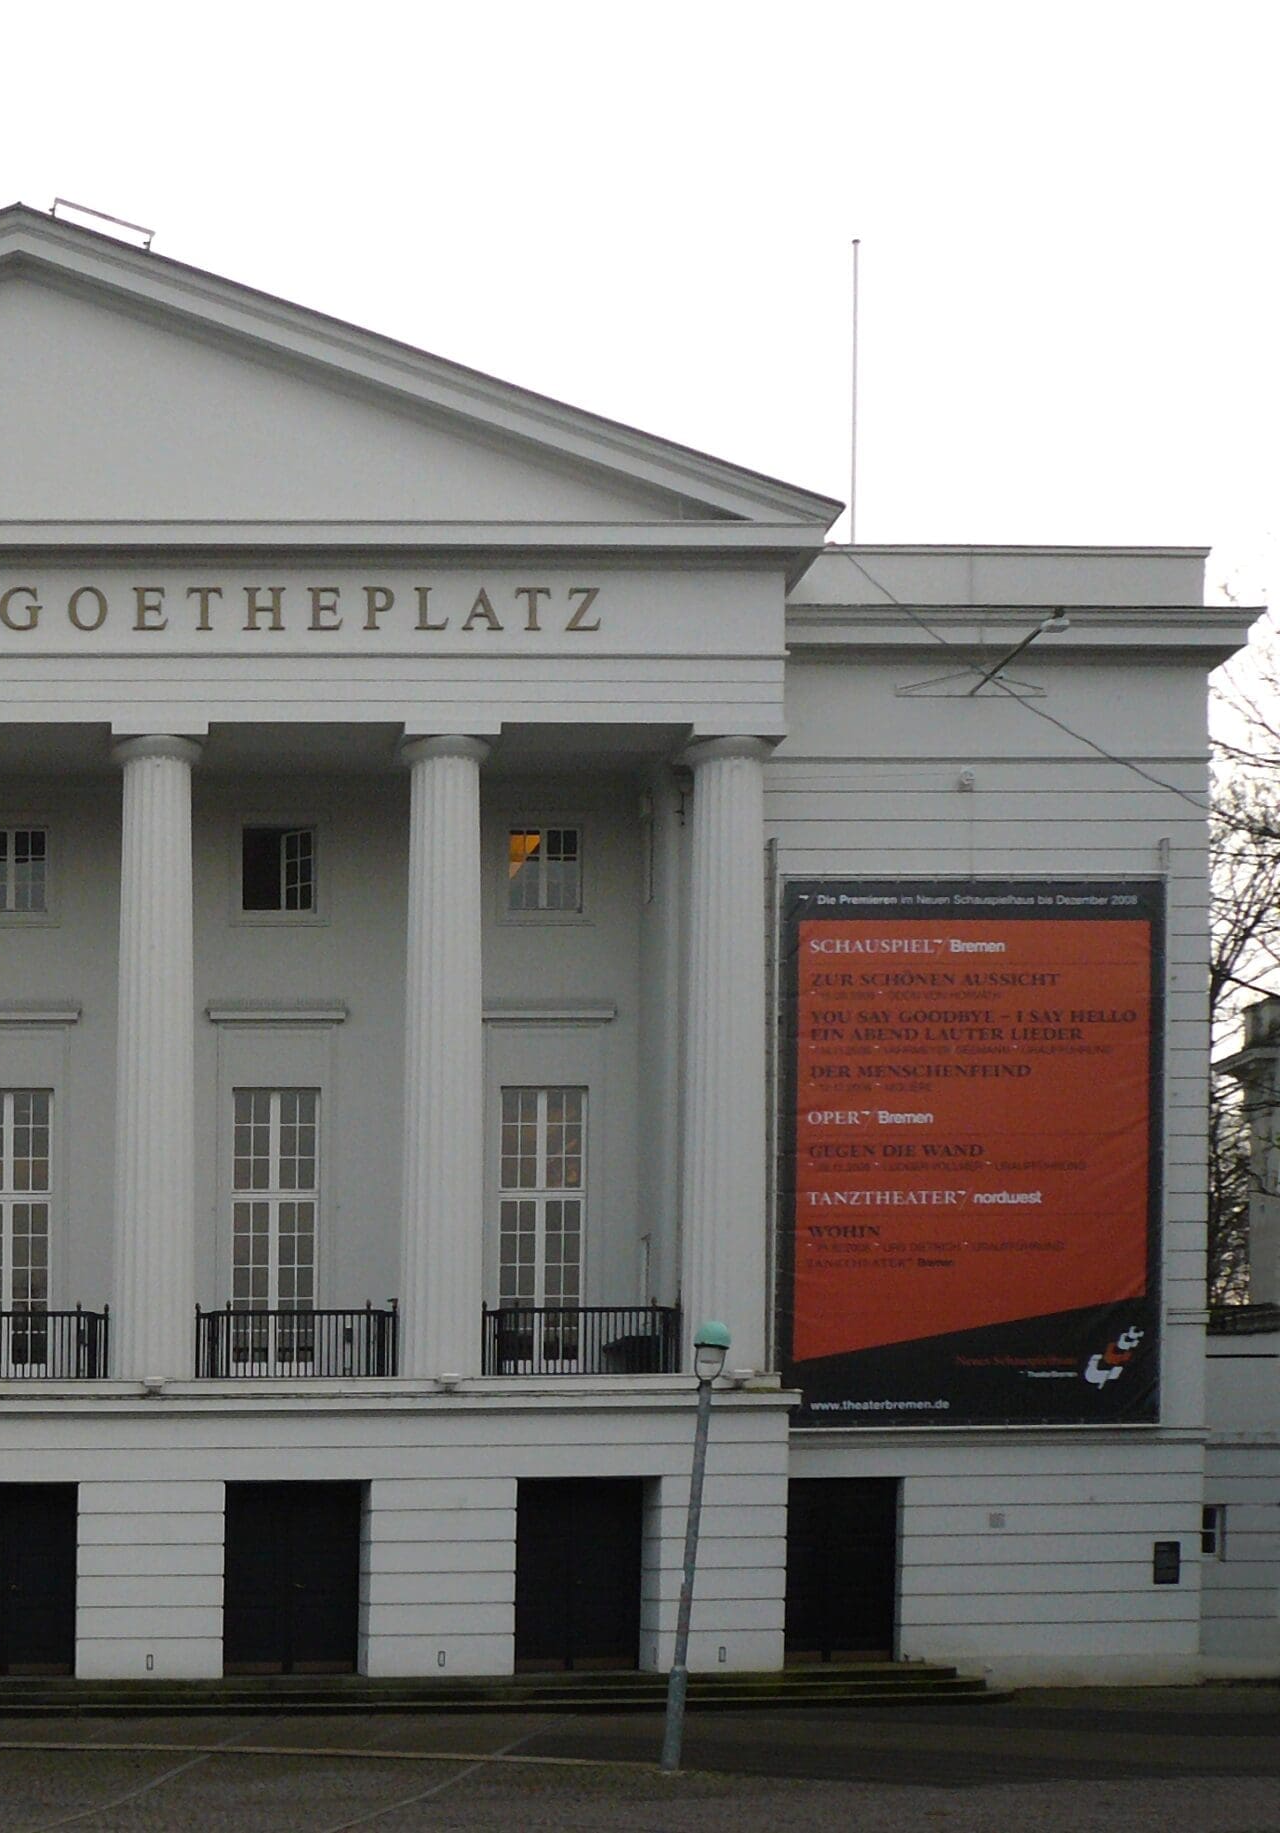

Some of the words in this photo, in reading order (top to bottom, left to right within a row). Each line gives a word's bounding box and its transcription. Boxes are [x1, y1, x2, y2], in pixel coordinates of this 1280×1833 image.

[840, 895, 897, 905] Premieren
[809, 939, 934, 953] SCHAUSPIEL
[950, 939, 1005, 953] Bremen
[812, 973, 853, 986] ZUR
[860, 972, 956, 986] SCHÖNEN
[962, 973, 1061, 986] AUSSICHT
[812, 1010, 848, 1023] YOU
[858, 1010, 891, 1023] SAY
[899, 1010, 994, 1023] GOODBYE
[1028, 1010, 1063, 1023] SAY
[1070, 1010, 1138, 1023] HELLO
[811, 1028, 844, 1041] EIN
[851, 1028, 918, 1041] ABEND
[925, 1028, 1003, 1041] LAUTER
[1010, 1028, 1083, 1041] LIEDER
[811, 1065, 850, 1078] DER
[858, 1065, 1031, 1078] MENSCHENFEIND
[807, 1111, 860, 1125] OPER
[878, 1111, 933, 1125] Bremen
[809, 1144, 876, 1157] GEGEN
[883, 1144, 916, 1157] DIE
[922, 1144, 985, 1157] WAND
[807, 1191, 958, 1205] TANZTHEATER
[973, 1191, 1042, 1205] nordwest
[808, 1226, 881, 1239] WOHIN
[810, 1399, 949, 1411] www.theaterbremen.de
